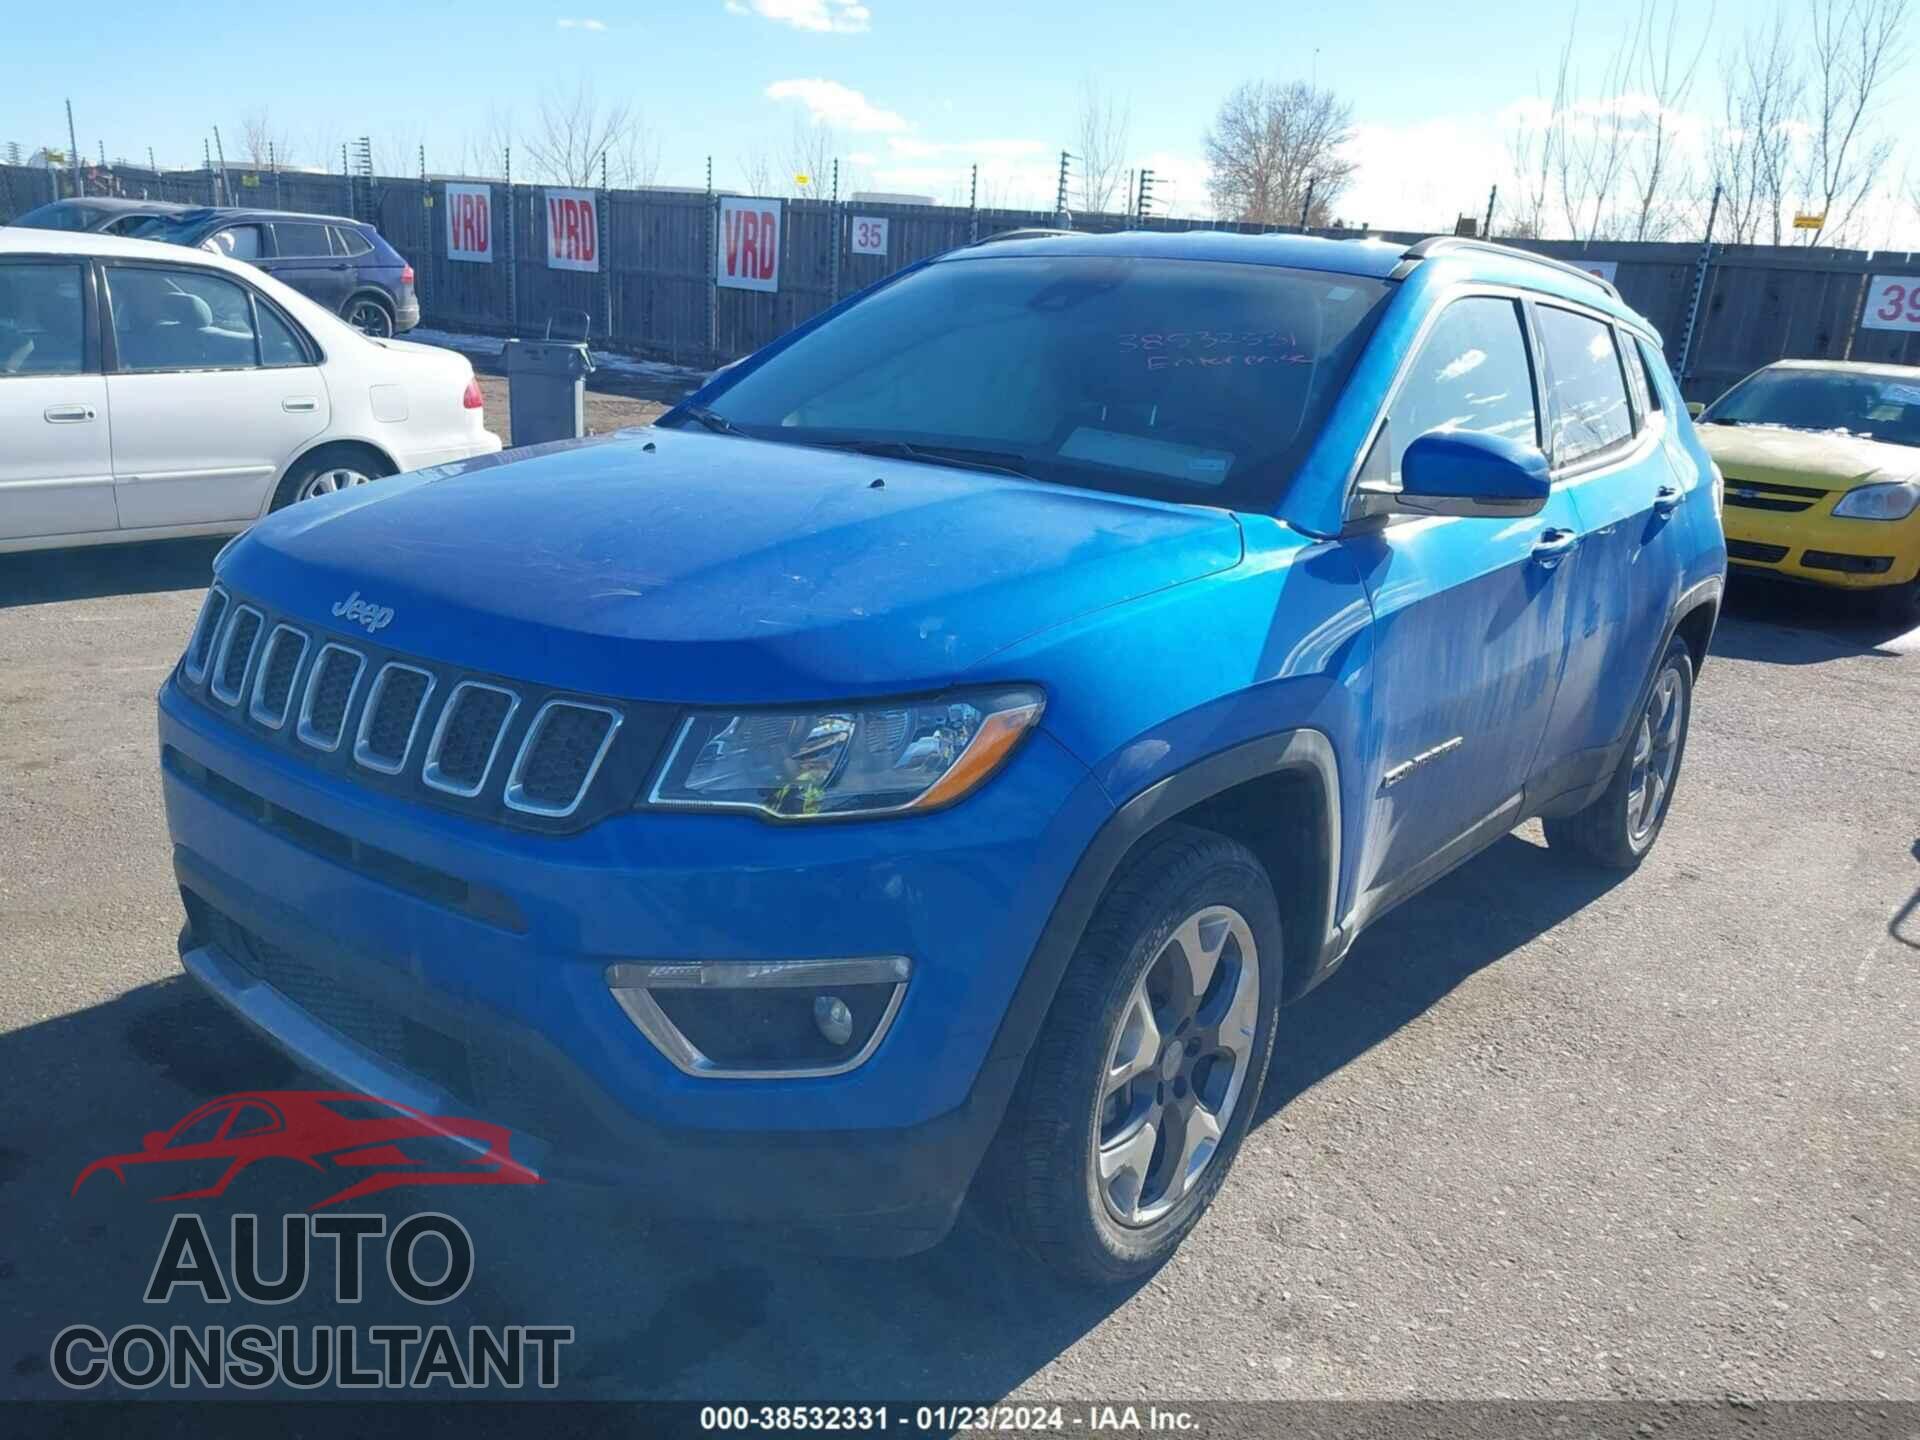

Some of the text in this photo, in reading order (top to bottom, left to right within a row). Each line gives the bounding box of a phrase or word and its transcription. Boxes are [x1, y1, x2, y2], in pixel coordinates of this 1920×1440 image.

[451, 193, 488, 253] VRD
[550, 198, 595, 261] VRD
[725, 209, 776, 280] VRD
[858, 223, 882, 248] 35
[331, 591, 395, 633] Jeep
